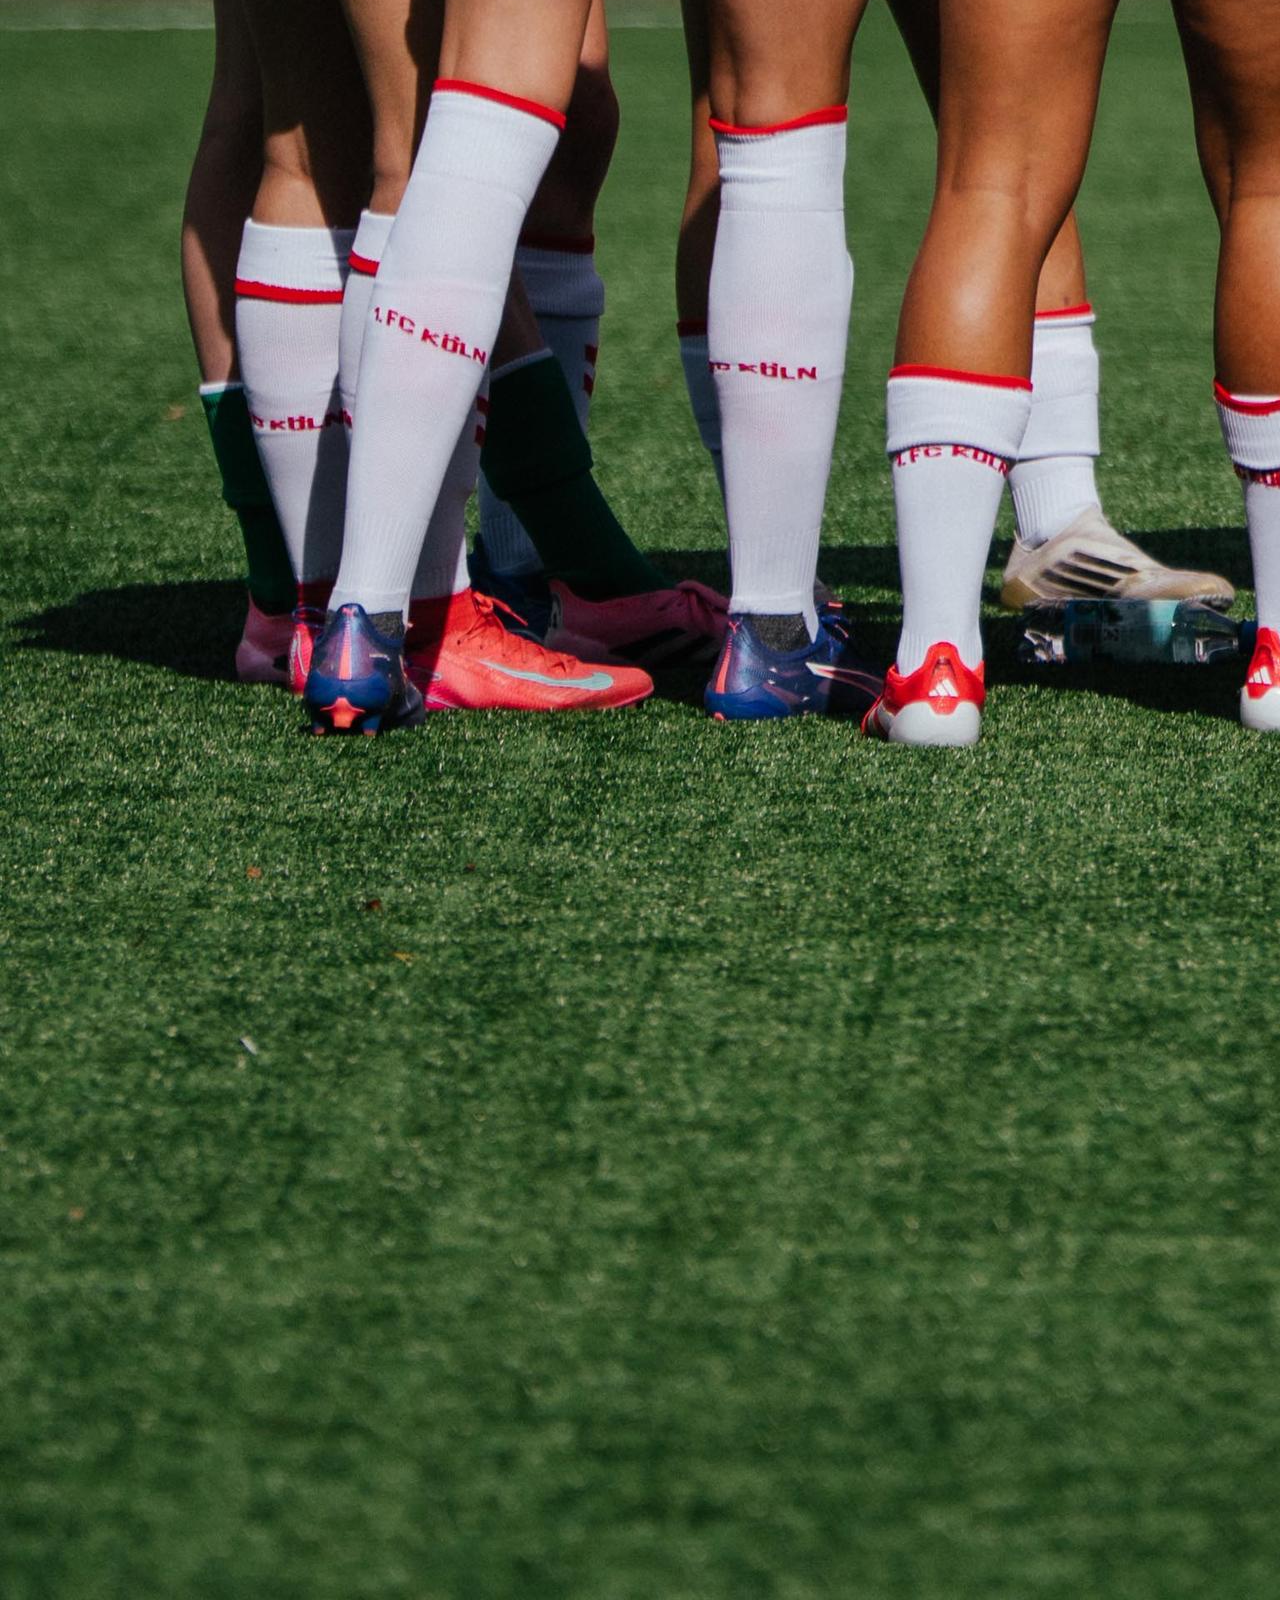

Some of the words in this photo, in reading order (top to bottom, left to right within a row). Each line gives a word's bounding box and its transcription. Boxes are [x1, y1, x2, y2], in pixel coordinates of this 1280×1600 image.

[421, 327, 487, 366] KÖLN
[738, 361, 817, 381] KÖLN
[909, 445, 943, 464] FC
